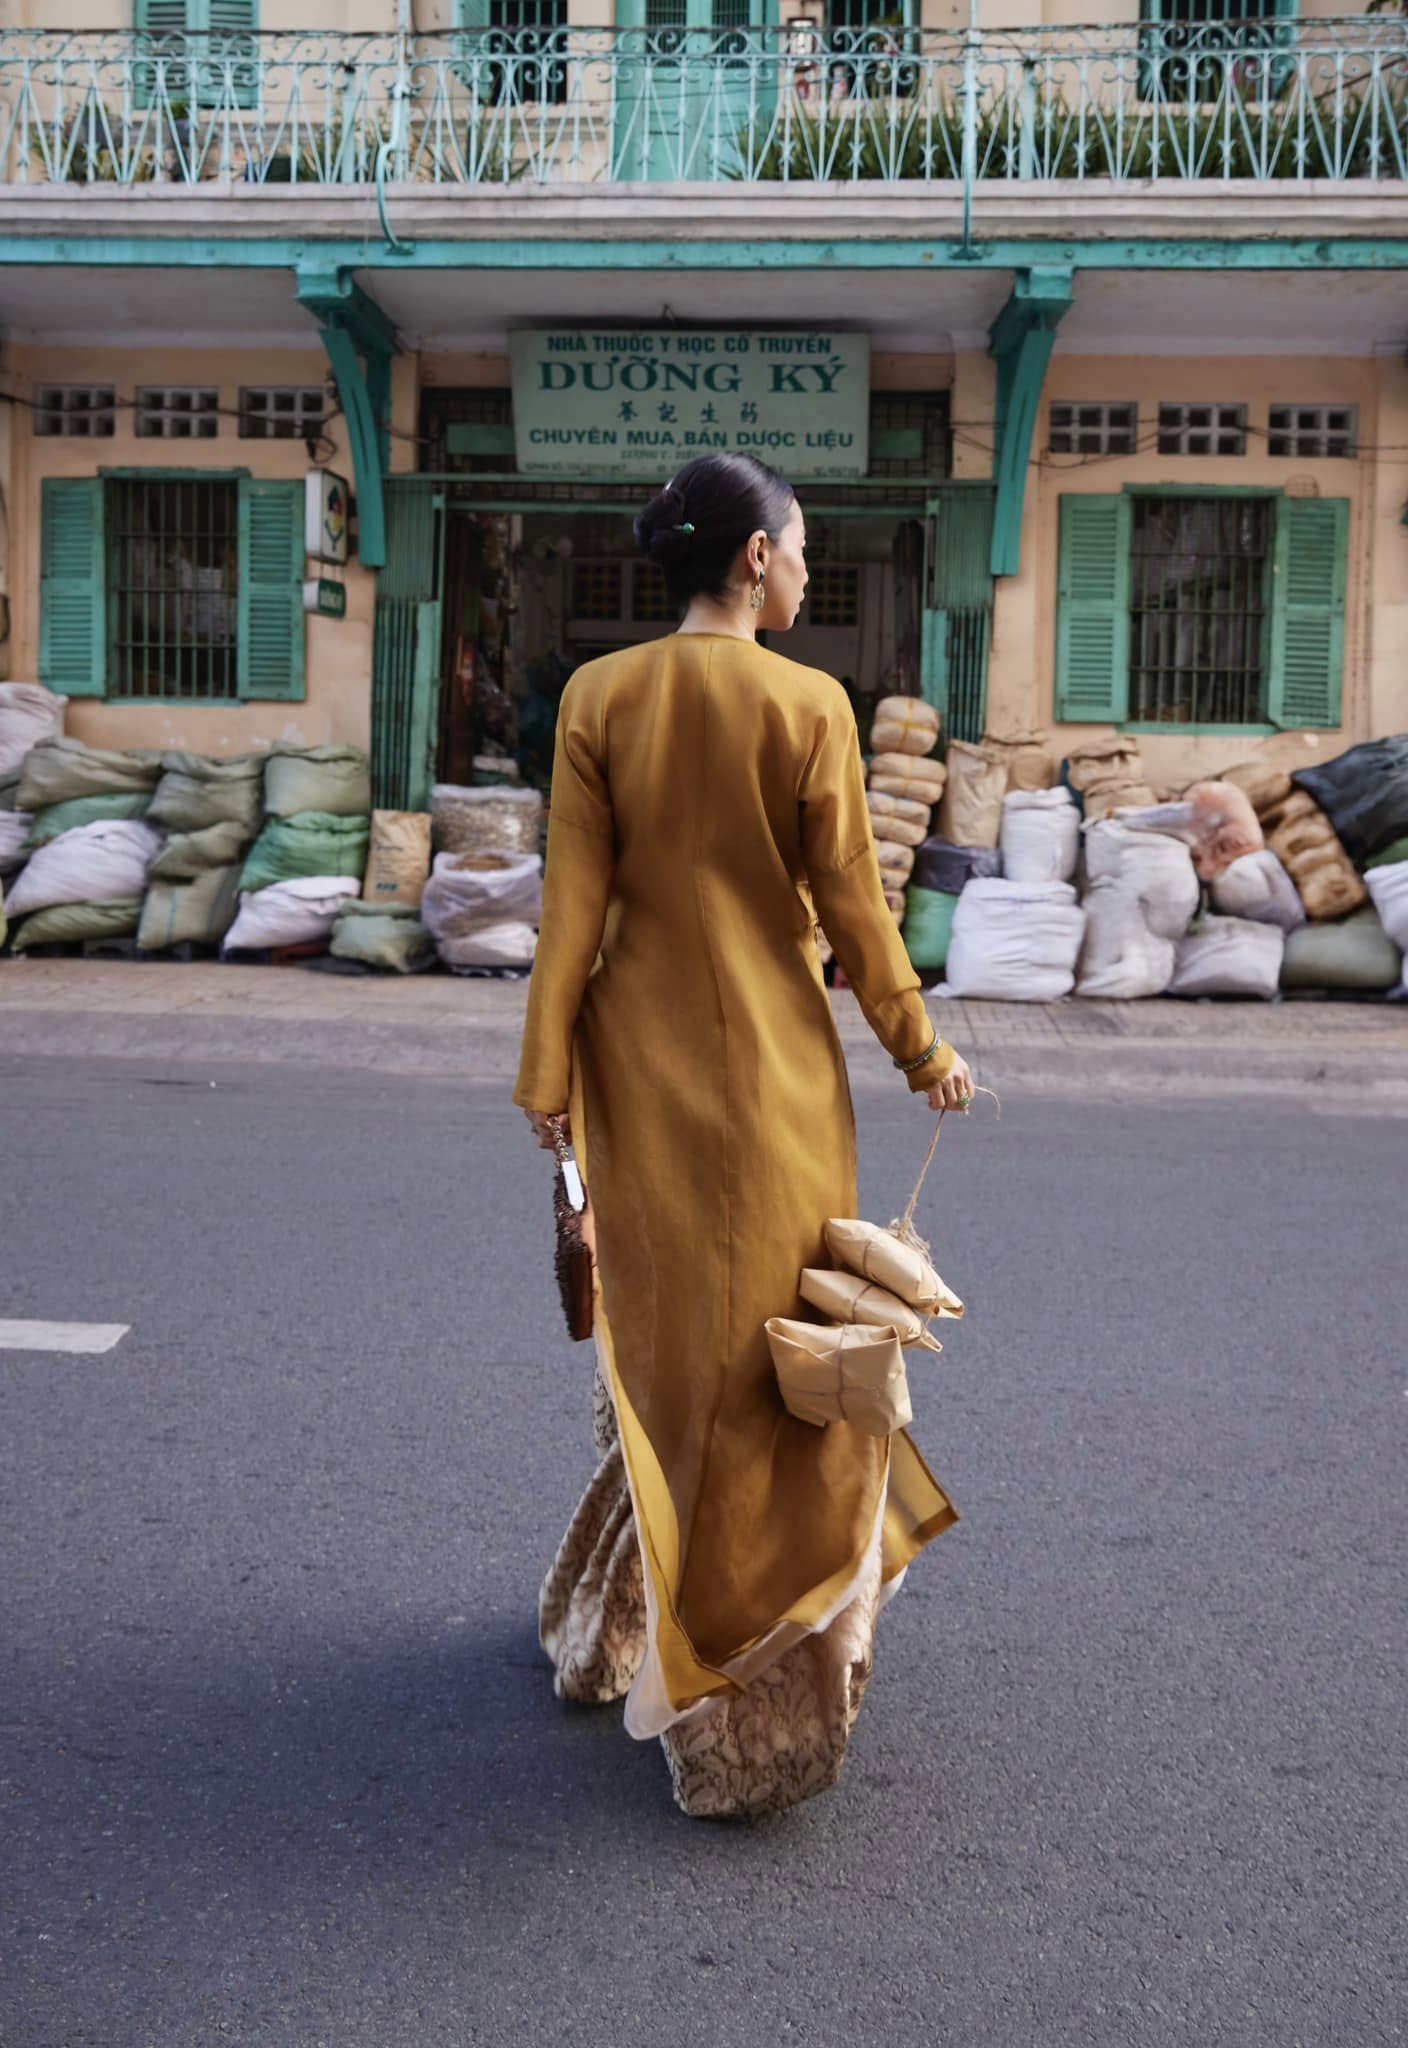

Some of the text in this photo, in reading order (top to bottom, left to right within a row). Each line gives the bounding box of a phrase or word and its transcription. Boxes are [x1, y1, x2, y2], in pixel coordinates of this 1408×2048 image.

[660, 336, 671, 352] Y
[678, 336, 715, 356] HỌC
[537, 355, 847, 393] DƯỠNG KÝ
[529, 426, 617, 445] CHUYÊN
[736, 430, 796, 450] DƯỢC
[806, 430, 853, 451] LIỆU
